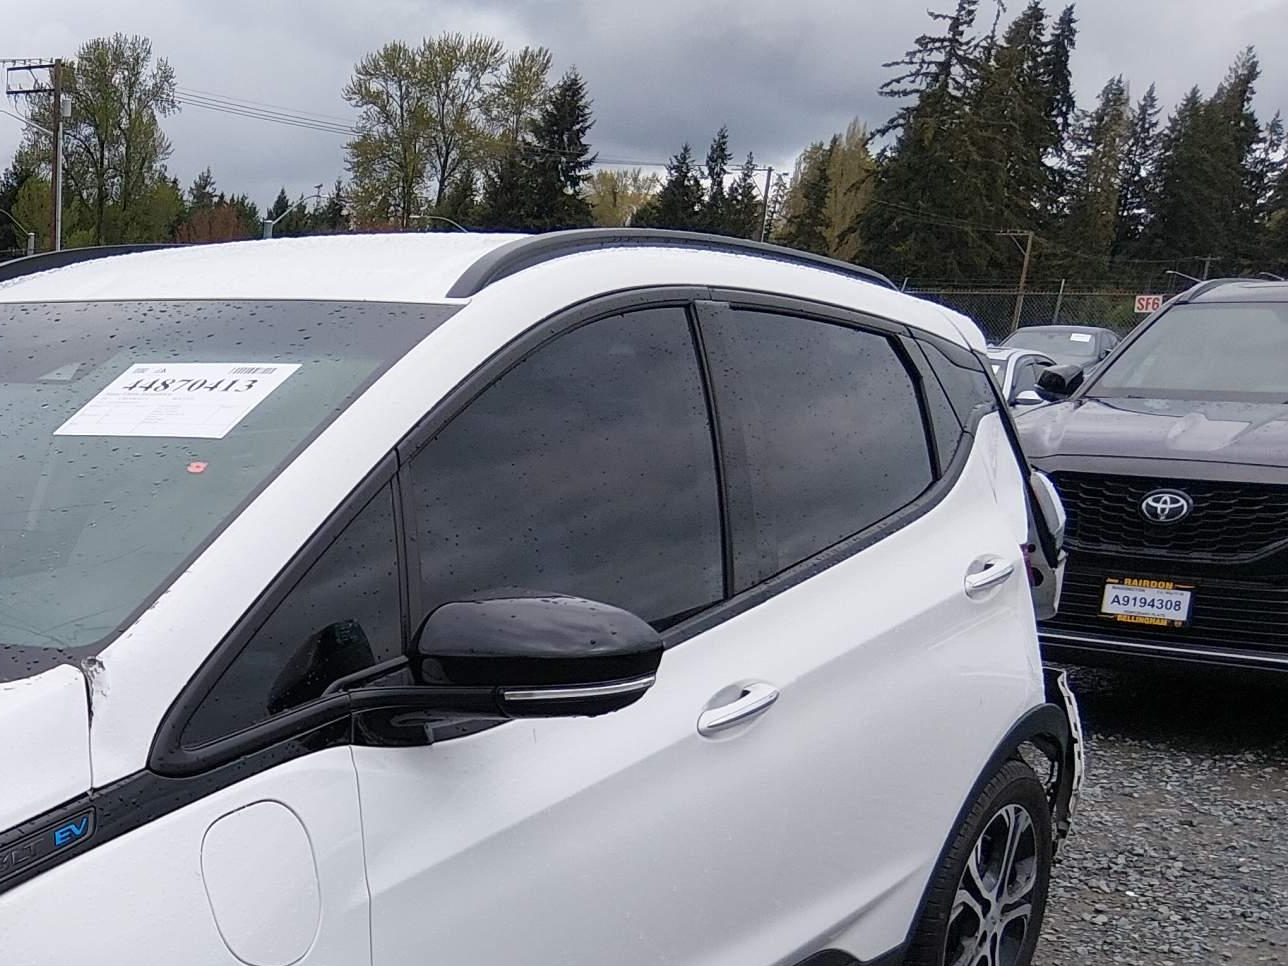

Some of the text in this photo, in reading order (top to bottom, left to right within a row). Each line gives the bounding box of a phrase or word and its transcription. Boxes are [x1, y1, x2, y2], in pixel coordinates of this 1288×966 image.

[1136, 297, 1161, 311] SF6
[122, 378, 259, 393] 44870413
[1123, 578, 1174, 590] RAIRDON
[1110, 594, 1182, 612] A9194308
[53, 816, 89, 847] EV
